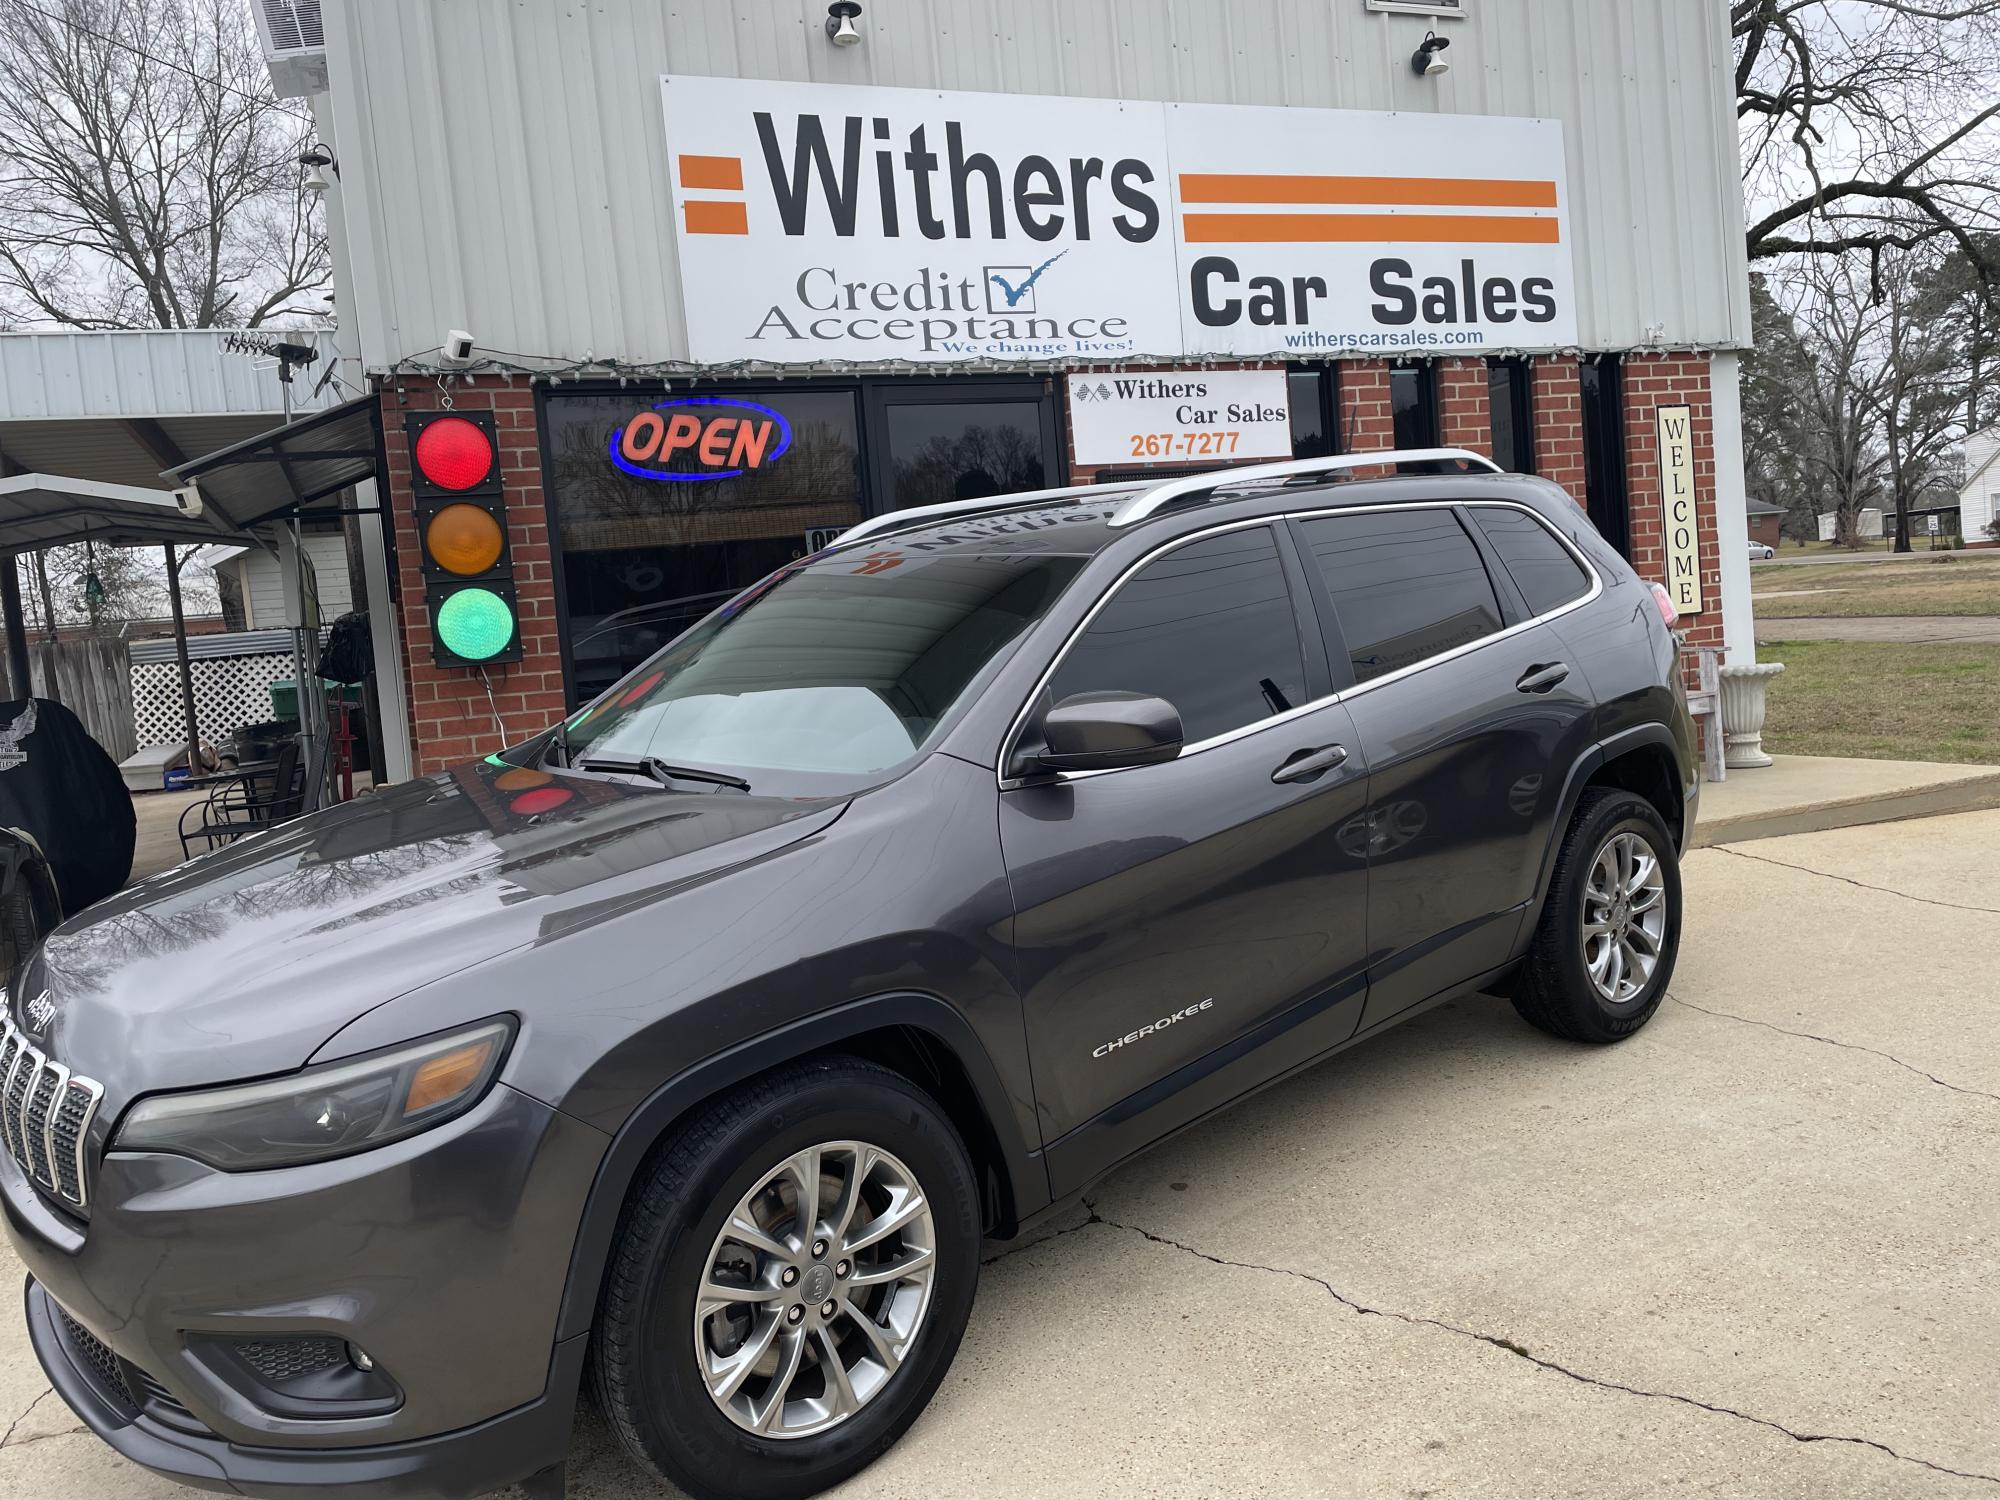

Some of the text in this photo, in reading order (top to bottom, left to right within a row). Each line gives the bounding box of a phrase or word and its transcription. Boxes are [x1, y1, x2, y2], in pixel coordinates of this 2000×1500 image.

[753, 112, 1160, 243] Withers
[796, 267, 976, 312] Credit
[1190, 256, 1557, 326] Car Sales
[745, 305, 1129, 352] Acceptance
[942, 339, 1134, 356] We change lives!
[1285, 329, 1484, 348] witherscarsales.com
[1113, 379, 1208, 400] Withers
[1175, 403, 1287, 425] Car Sales
[622, 412, 773, 468] OPEN
[1130, 431, 1240, 457] 267-7277
[1664, 416, 1694, 605] WELCOME
[1092, 997, 1214, 1058] CHEROKEE
